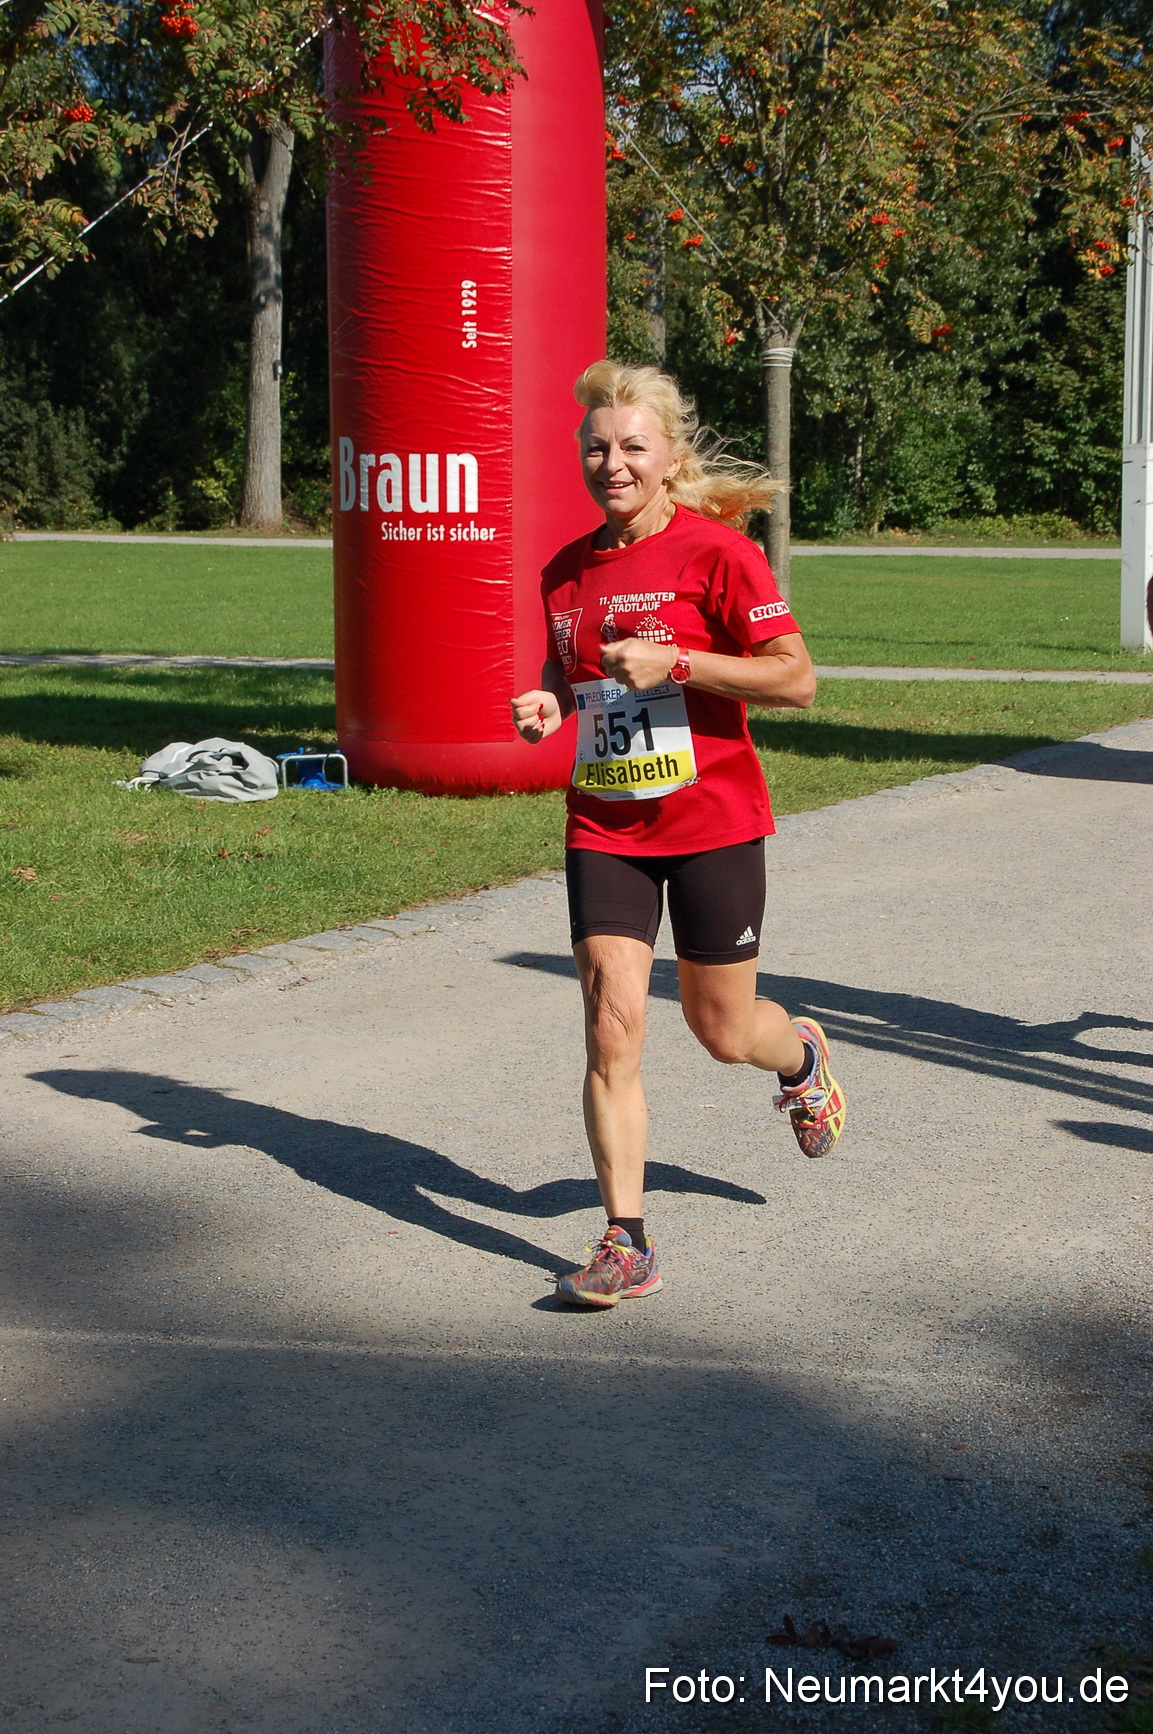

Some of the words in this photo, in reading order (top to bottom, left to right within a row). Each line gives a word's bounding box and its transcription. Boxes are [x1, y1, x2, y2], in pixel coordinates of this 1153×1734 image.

[461, 279, 477, 316] 1929
[461, 321, 478, 349] Seit
[338, 436, 479, 514] Braun
[381, 520, 423, 541] Sicher
[427, 522, 445, 541] ist
[450, 520, 497, 541] sicher
[599, 596, 610, 606] 11.
[611, 592, 676, 604] NEUMARKTER
[608, 601, 661, 613] STADTLAUF
[751, 602, 789, 620] BOCK
[593, 707, 655, 758] 551
[585, 754, 679, 787] Elisabeth
